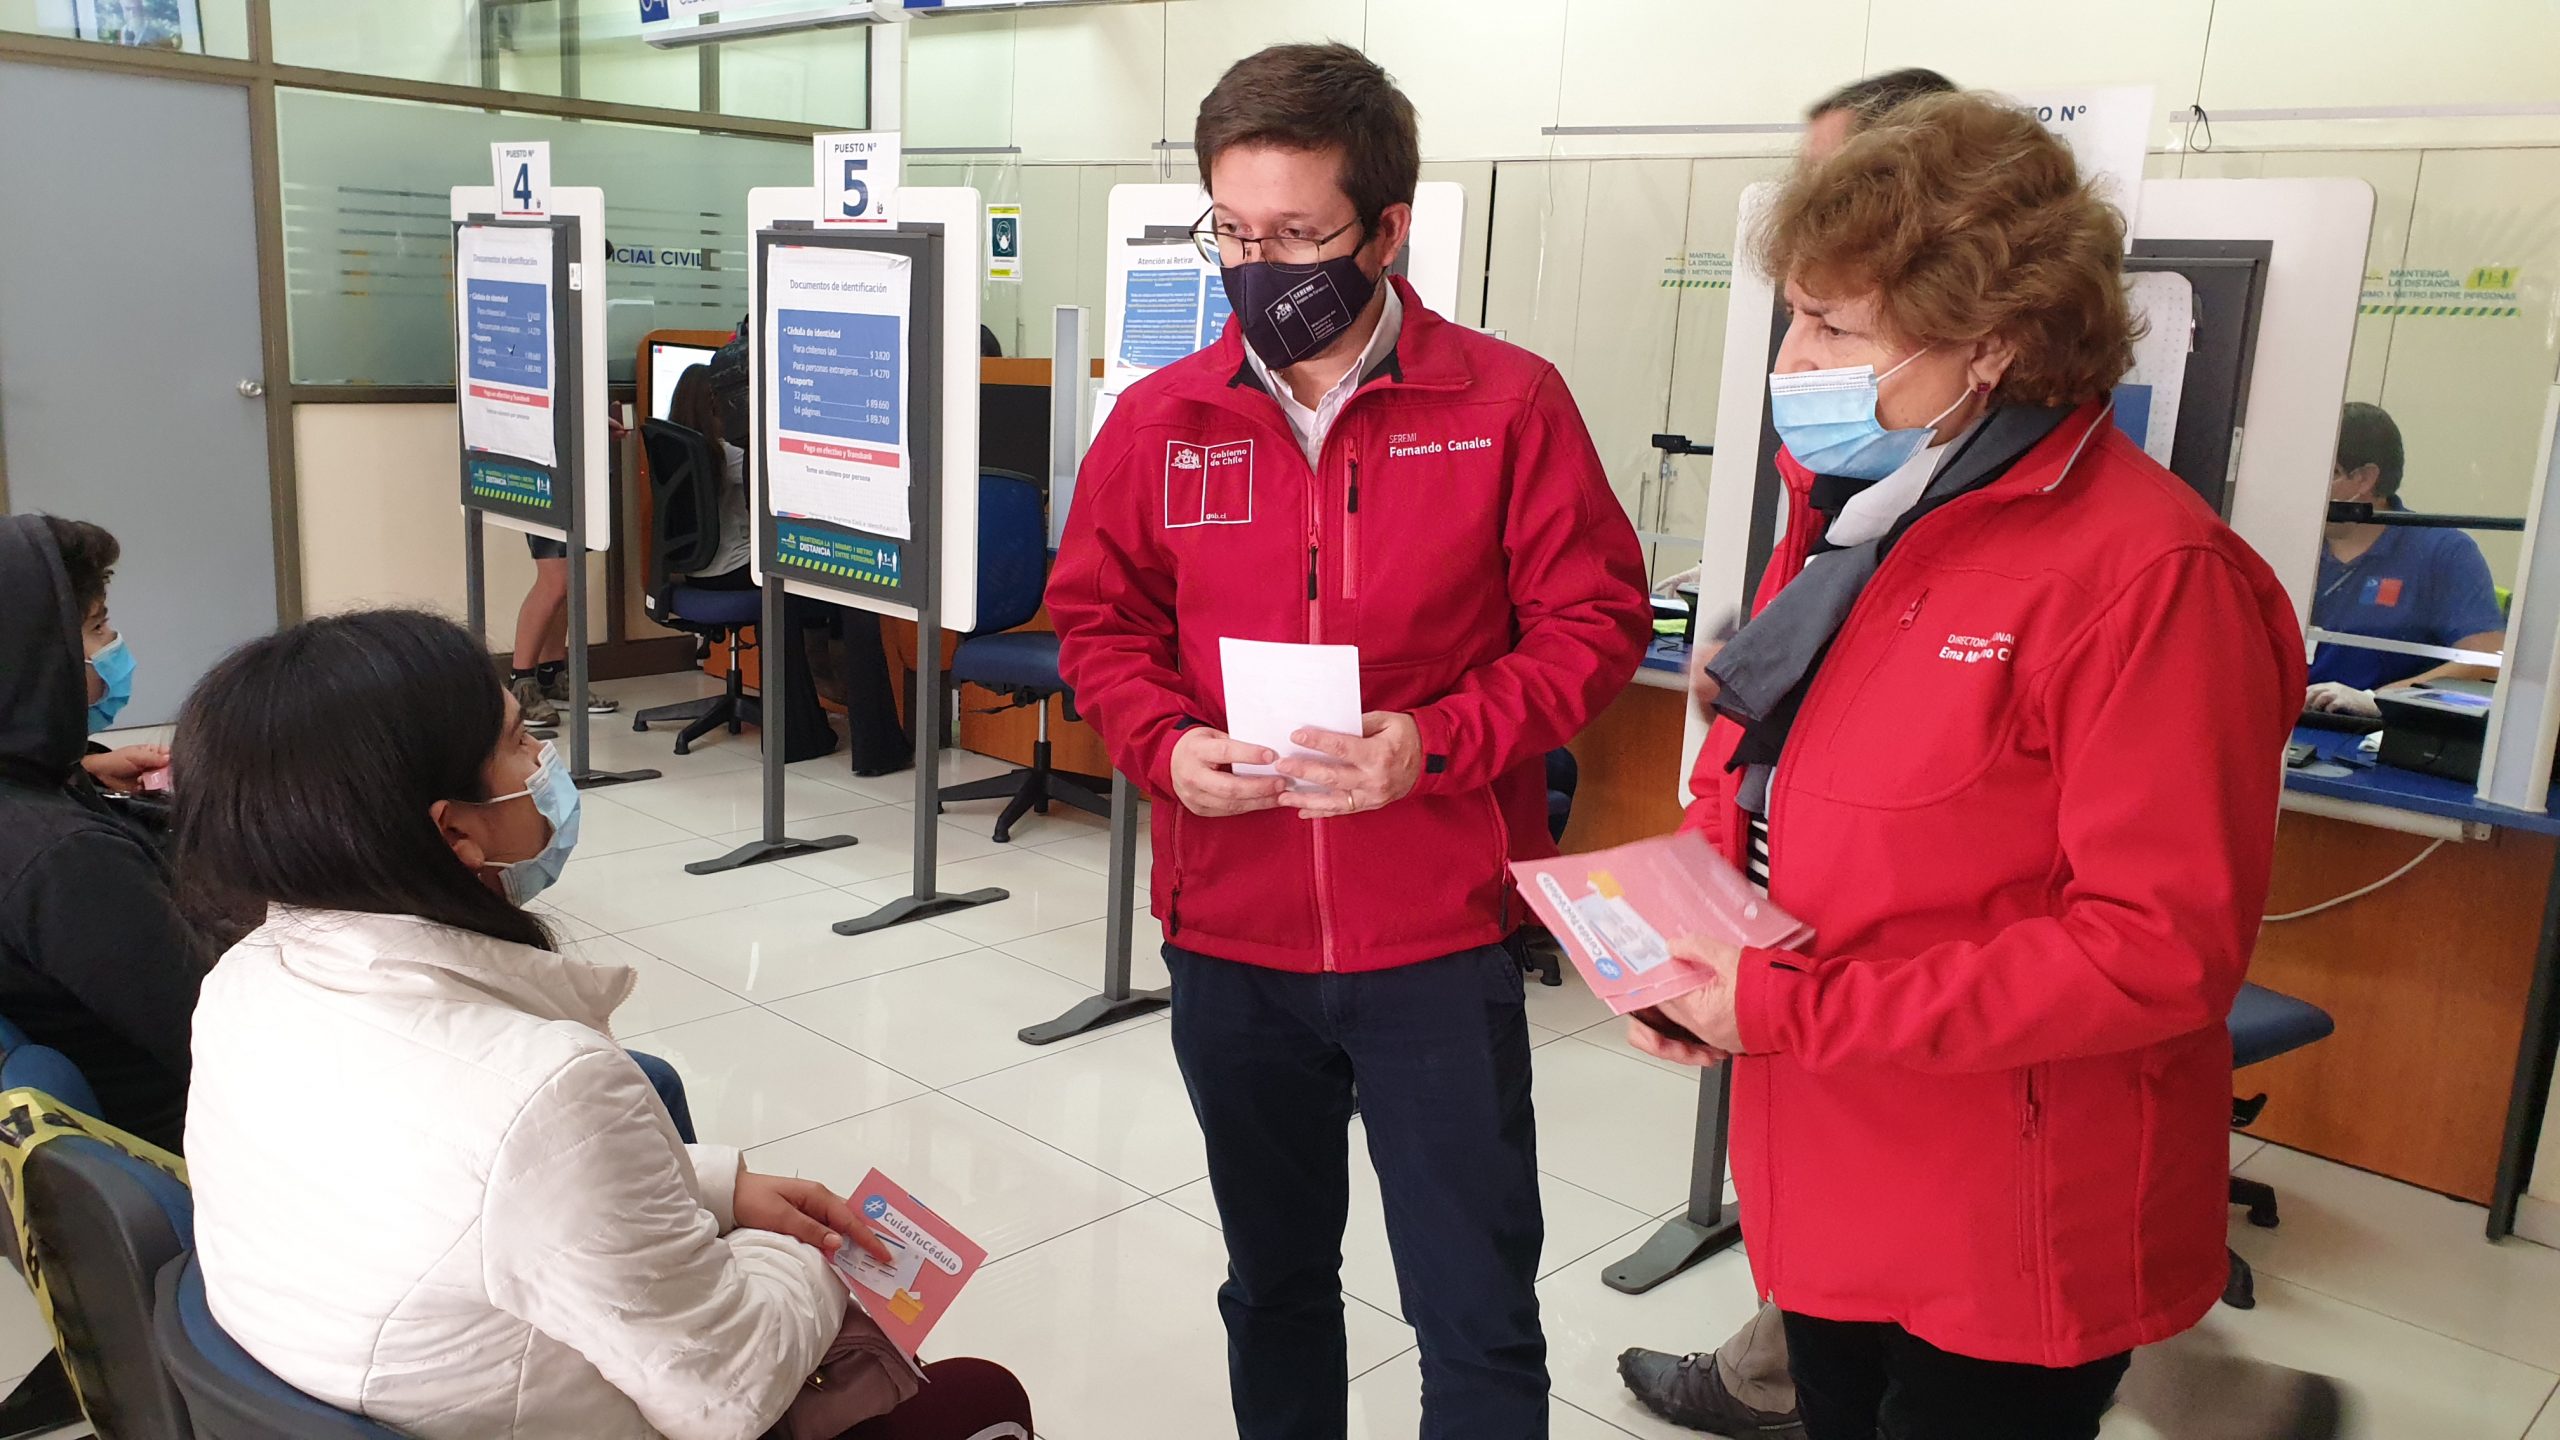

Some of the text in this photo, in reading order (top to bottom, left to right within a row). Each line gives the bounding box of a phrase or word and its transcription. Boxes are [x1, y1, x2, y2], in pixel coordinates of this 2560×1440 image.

[506, 150, 527, 158] PUESTO
[834, 143, 865, 153] PUESTO
[513, 163, 532, 210] 4
[843, 159, 868, 217] 5
[611, 249, 702, 266] ICIAL CIVIL
[1138, 257, 1166, 265] Atención
[1174, 256, 1194, 264] Retirar
[2389, 269, 2449, 278] MANTENGA
[790, 279, 887, 293] Documentos de identificación
[2388, 279, 2460, 288] LA DISTANCIA
[2394, 291, 2427, 299] METRO
[2430, 291, 2461, 299] ENTRE
[2464, 291, 2516, 301] PERSONAS
[807, 328, 814, 337] de
[814, 328, 840, 338] identidad
[793, 344, 805, 353] Para
[793, 361, 805, 371] Para
[806, 362, 828, 373] personas
[829, 366, 858, 377] extranjeras
[787, 375, 814, 387] Pasaporte
[1389, 432, 1417, 444] SEREMI
[1389, 437, 1492, 458] Fernando Canales
[1210, 449, 1247, 459] Gobierno
[1222, 457, 1243, 465] Chile
[800, 543, 831, 557] DISTANCIA
[1939, 646, 1964, 661] Ema
[864, 1199, 957, 1271] #CuidaTuCédula
